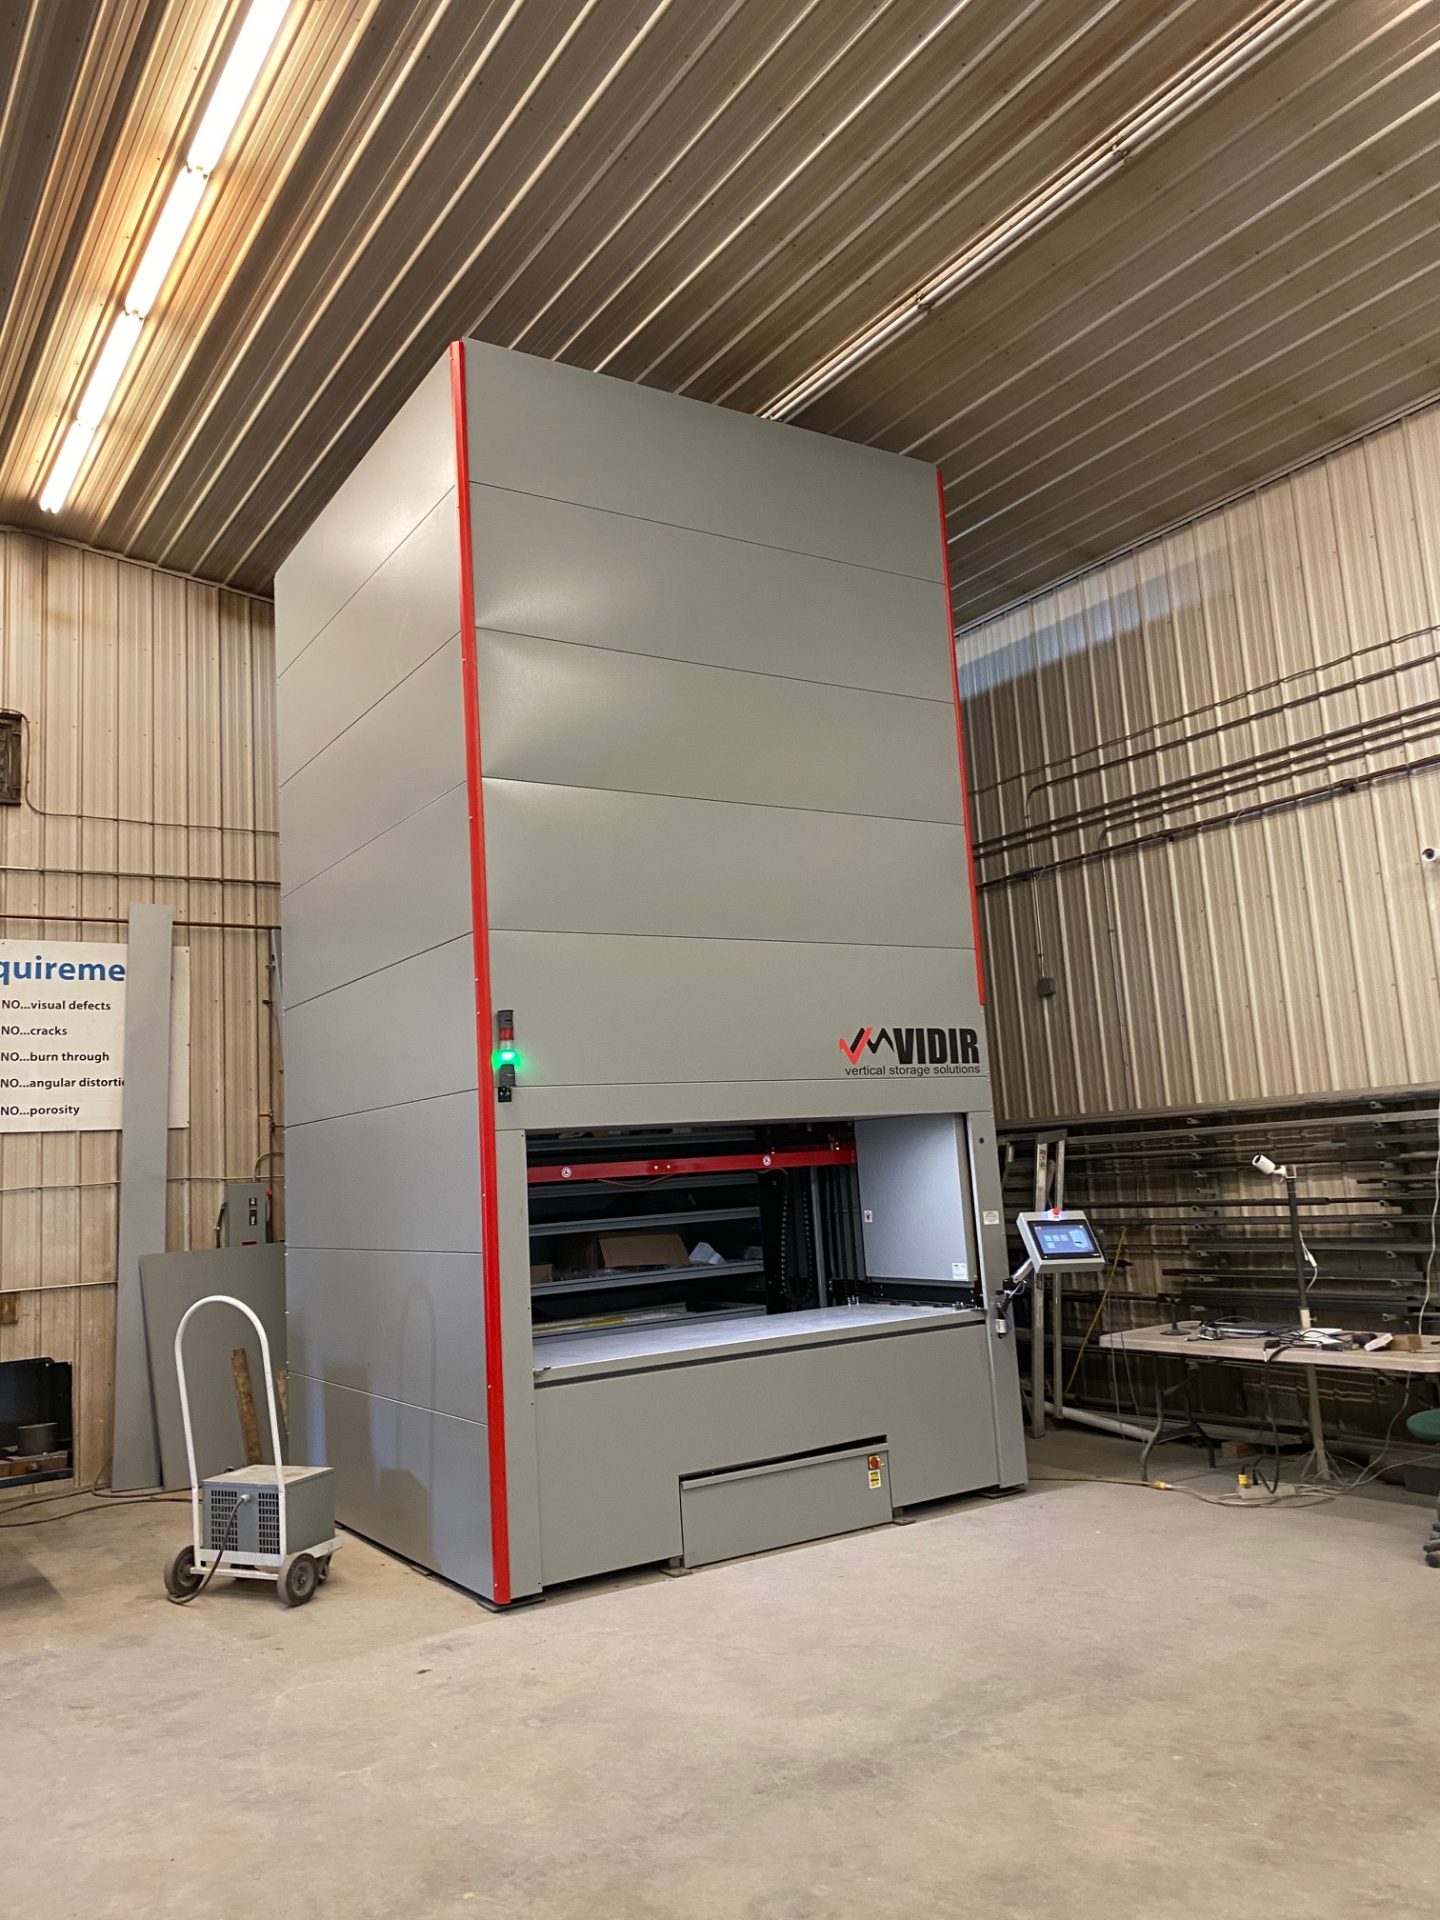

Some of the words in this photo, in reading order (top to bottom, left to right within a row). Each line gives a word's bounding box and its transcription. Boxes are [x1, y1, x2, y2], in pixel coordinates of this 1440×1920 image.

[2, 1000, 65, 1010] NO...visual
[68, 1001, 111, 1010] defects
[1, 1026, 68, 1036] NO...cracks
[893, 1028, 980, 1064] VIDIR
[0, 1052, 59, 1062] NO...burn
[61, 1052, 110, 1063] through
[844, 1065, 886, 1076] vertical
[889, 1065, 931, 1077] storage
[933, 1064, 981, 1075] solutions
[0, 1078, 76, 1090] NO...angular
[0, 1105, 80, 1117] NO...porosity
